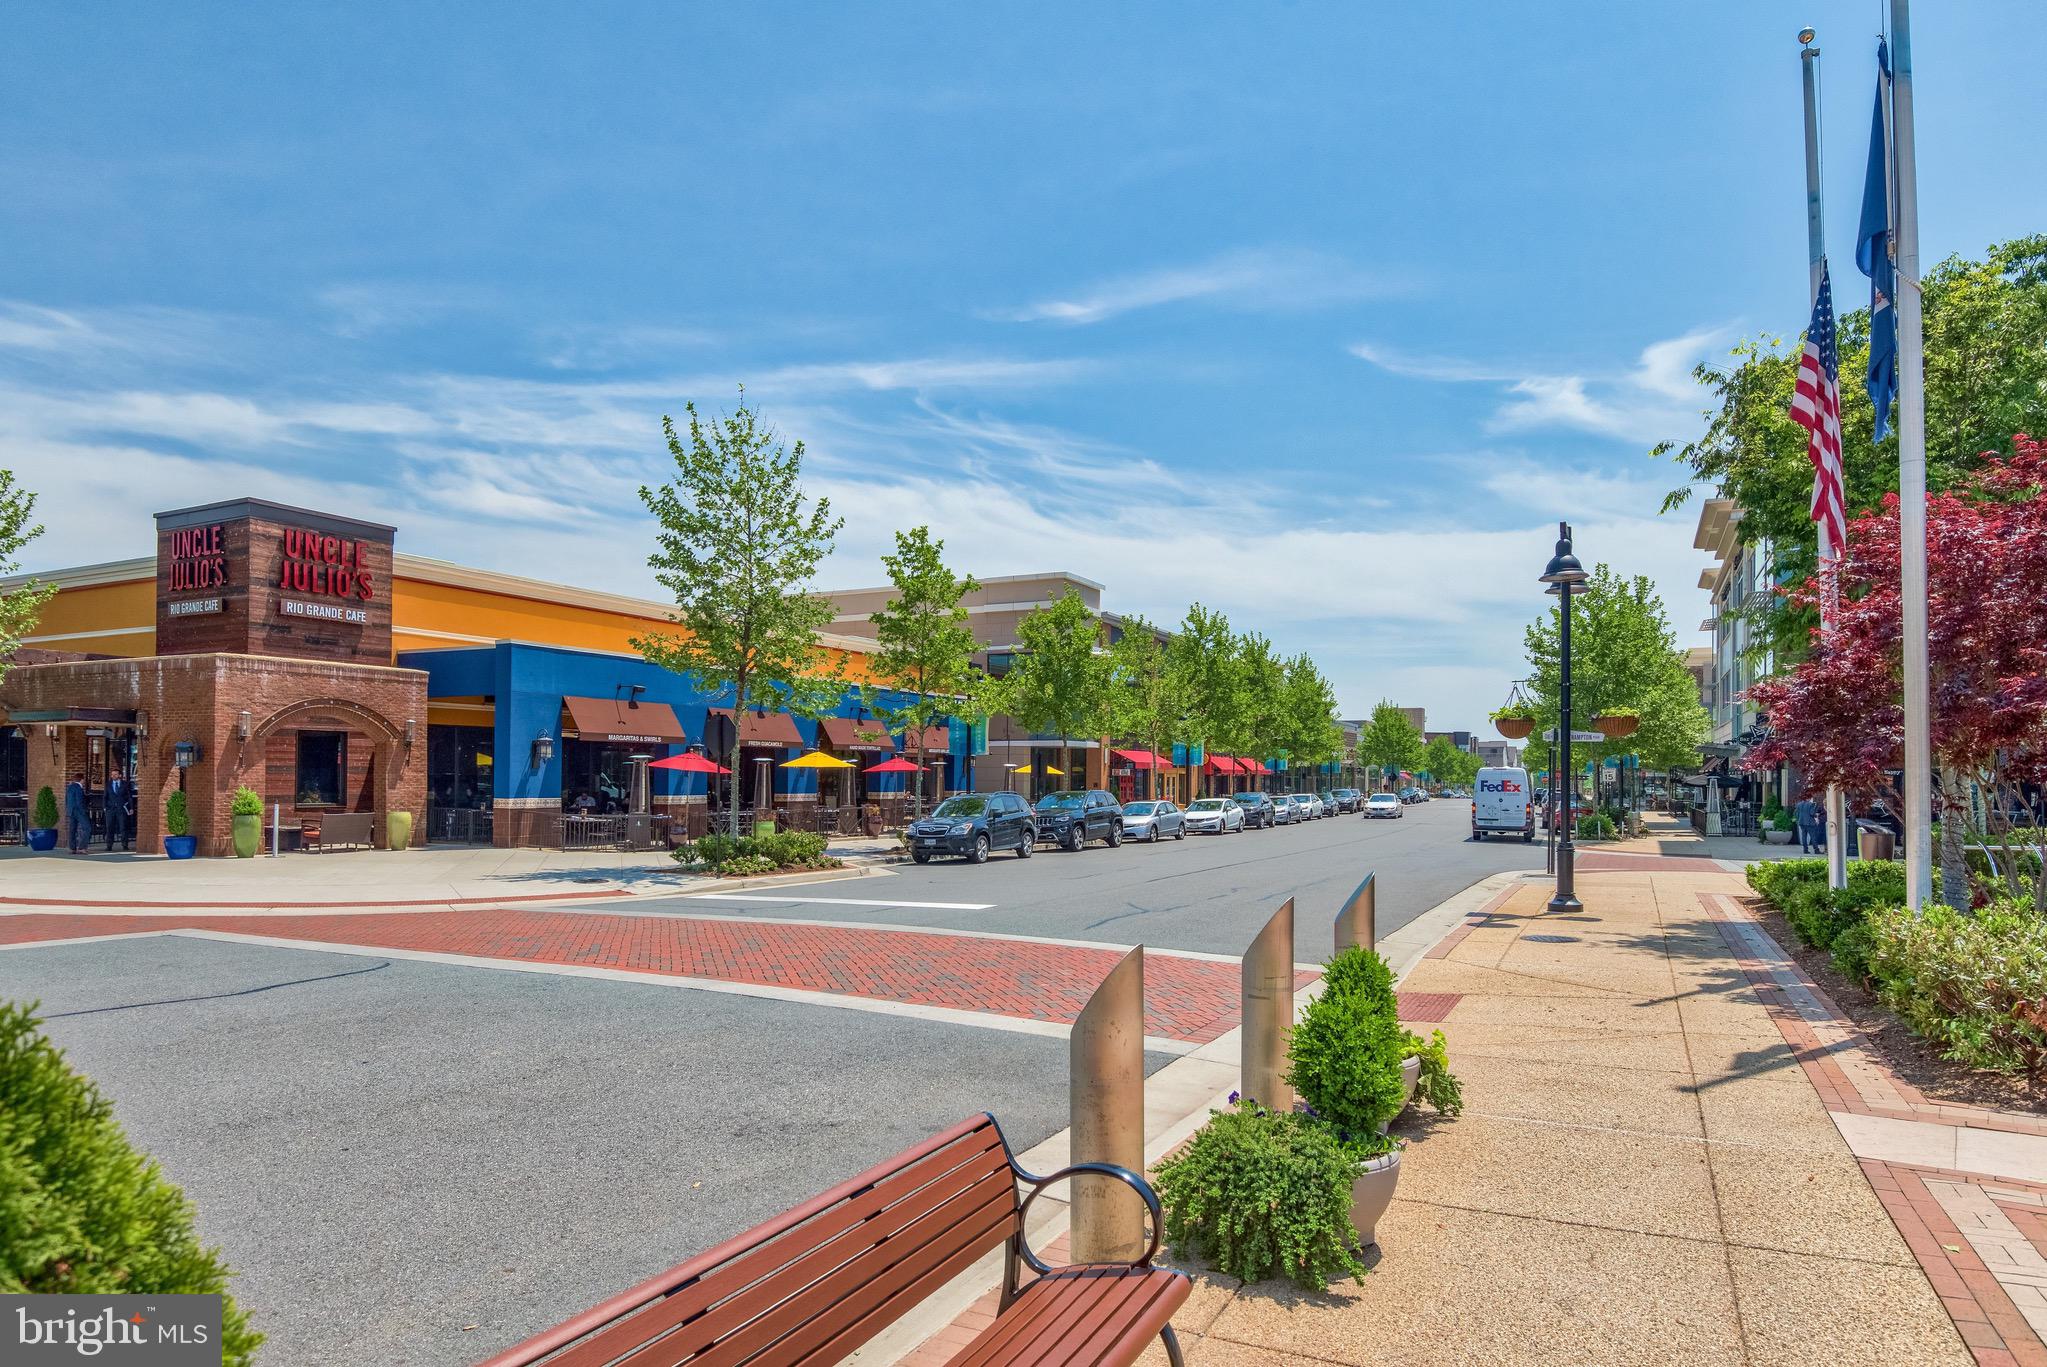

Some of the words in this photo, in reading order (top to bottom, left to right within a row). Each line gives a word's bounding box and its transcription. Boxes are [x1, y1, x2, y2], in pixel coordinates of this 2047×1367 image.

[172, 525, 221, 560] UNCLE
[284, 527, 369, 569] UNCLE
[168, 557, 224, 592] JULIO'S
[280, 560, 374, 601] JULIO'S
[170, 603, 180, 615] RIO
[181, 601, 204, 614] GRANDE
[204, 599, 219, 612] CAFE
[286, 601, 304, 614] RIO
[306, 604, 343, 620] GRANDE
[345, 609, 367, 623] CAFE
[608, 734, 639, 742] MARGARITAS
[1480, 780, 1521, 792] FedEx
[1604, 773, 1614, 781] 15
